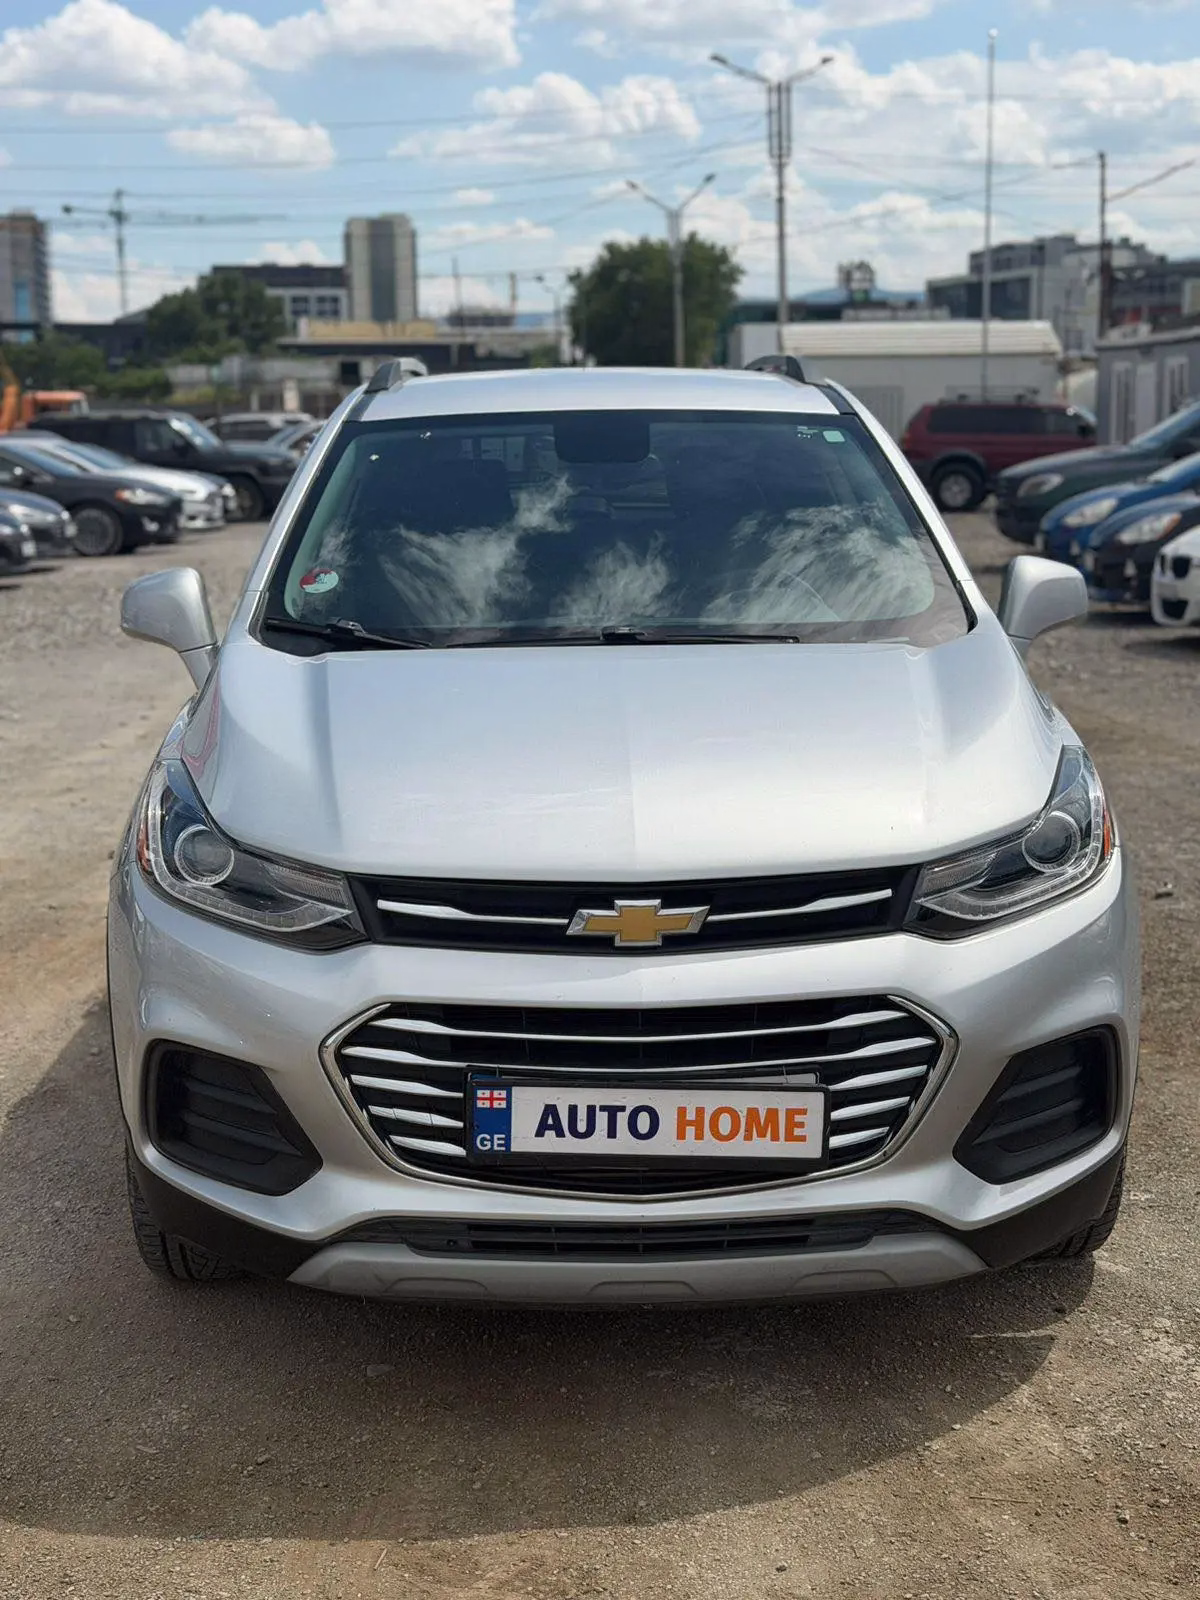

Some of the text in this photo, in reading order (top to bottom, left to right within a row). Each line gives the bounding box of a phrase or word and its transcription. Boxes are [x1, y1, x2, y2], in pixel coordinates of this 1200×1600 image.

[534, 1103, 808, 1142] AUTO HOME
[476, 1133, 506, 1151] GE
